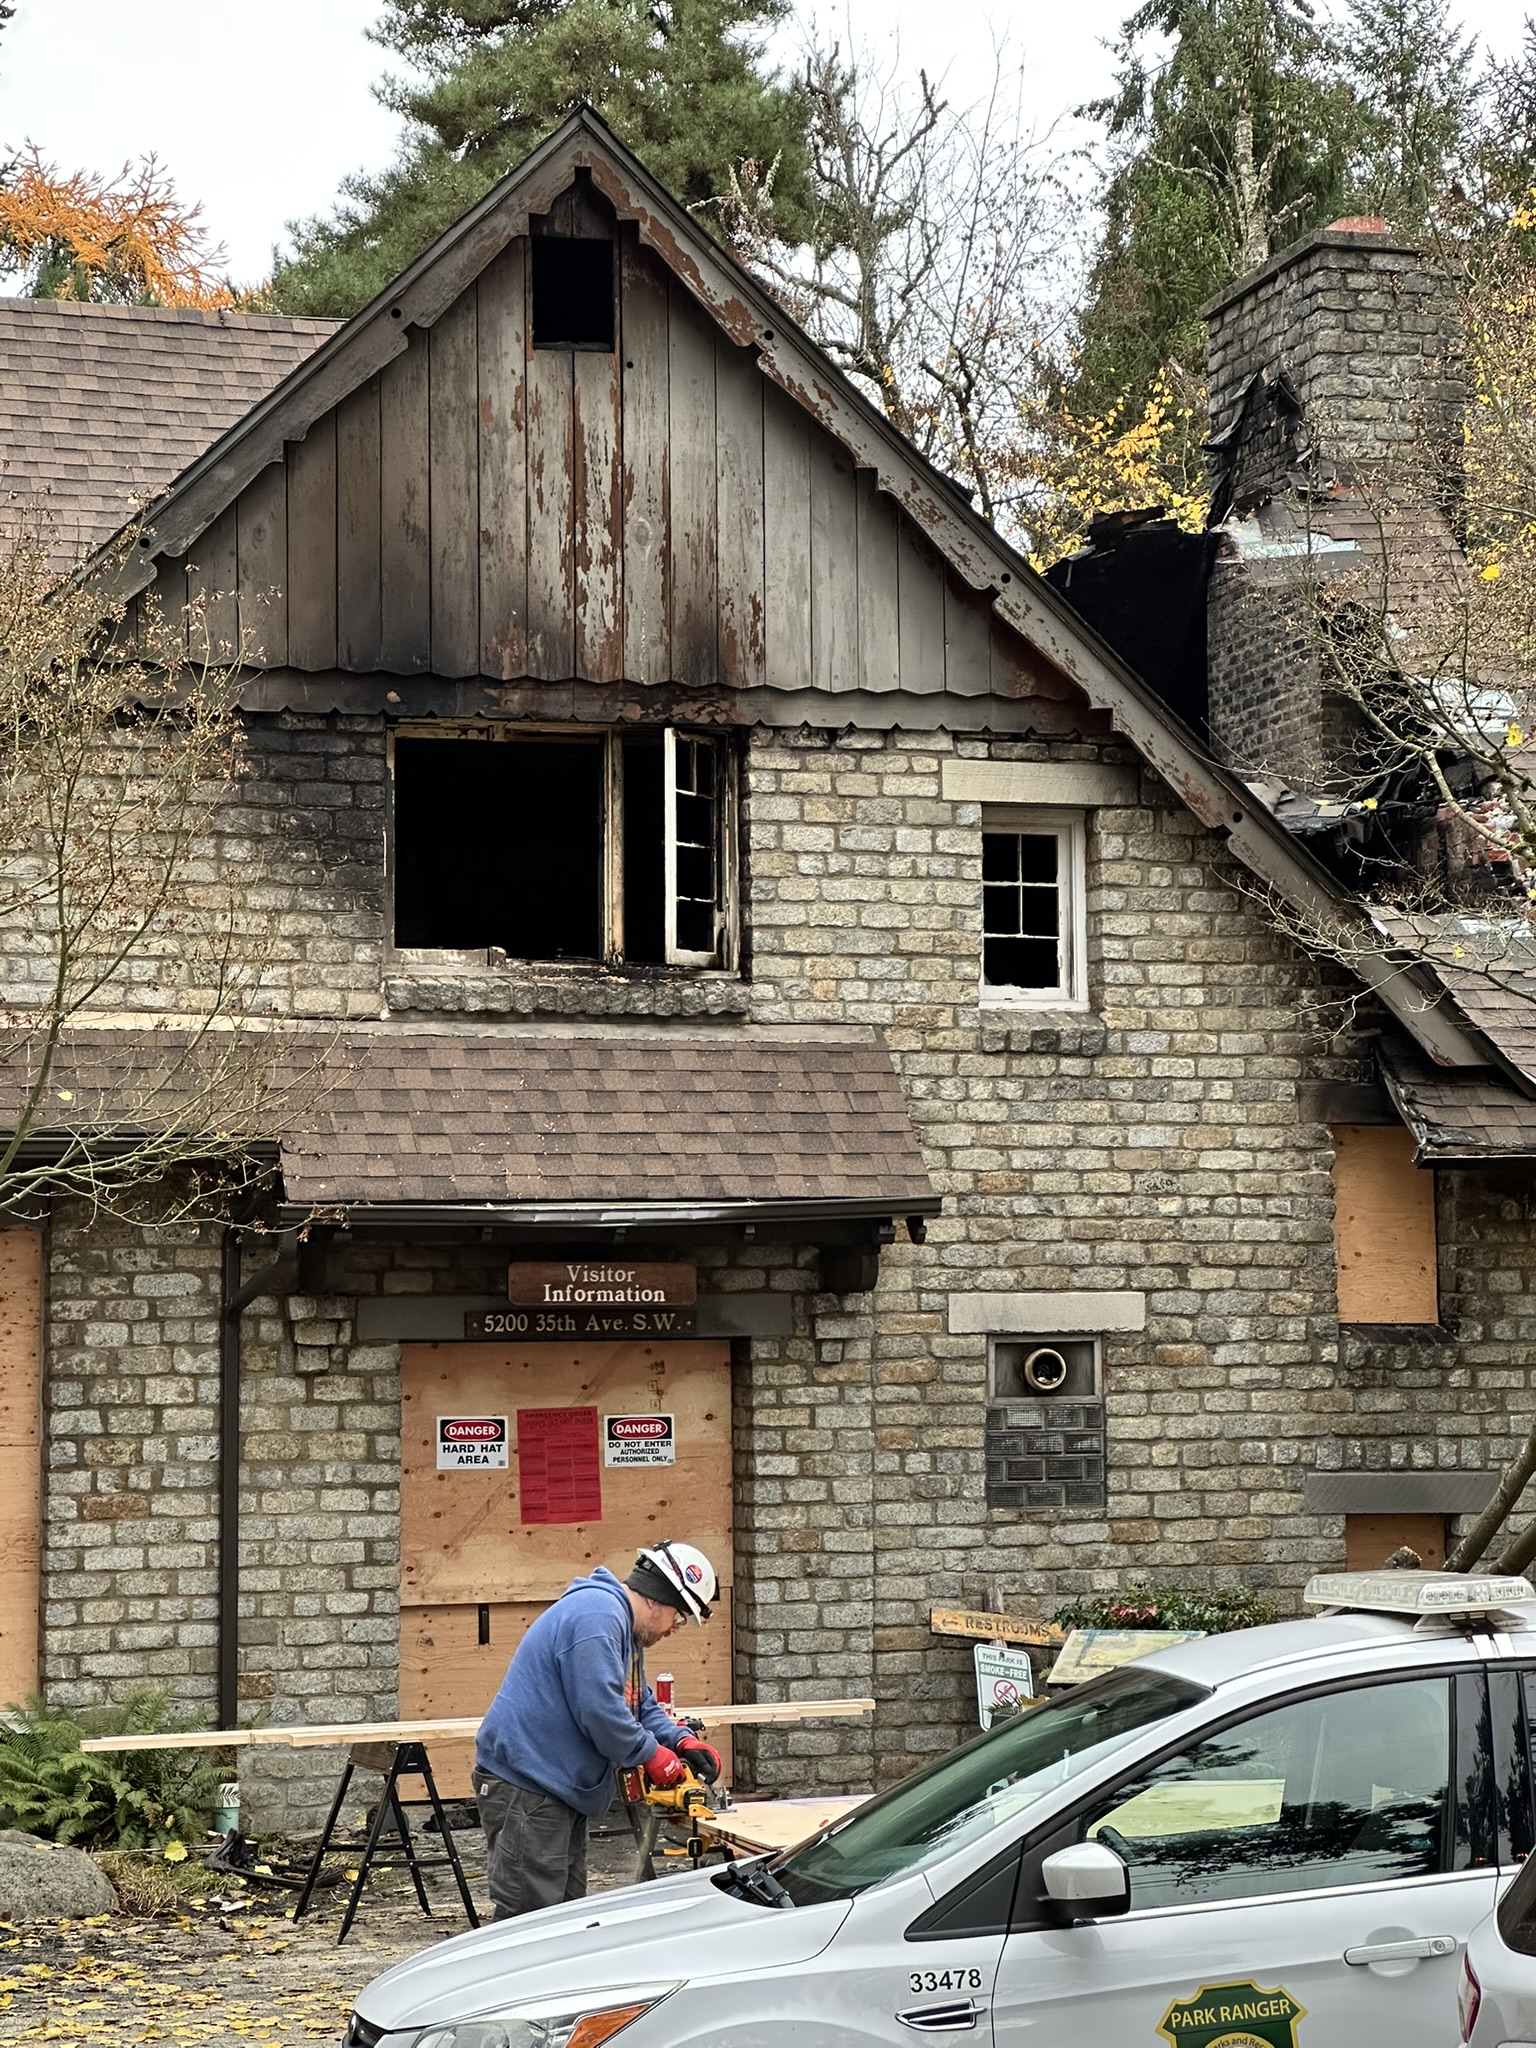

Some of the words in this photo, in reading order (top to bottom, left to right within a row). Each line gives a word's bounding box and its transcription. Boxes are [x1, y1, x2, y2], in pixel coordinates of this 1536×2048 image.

[566, 1264, 636, 1283] Visitor
[543, 1284, 667, 1302] Information
[483, 1314, 529, 1333] 5200
[535, 1314, 577, 1332] 35th
[585, 1314, 629, 1332] Ave.
[633, 1313, 682, 1331] S.W.
[449, 1426, 496, 1436] DANGER
[616, 1423, 663, 1434] DANGER
[442, 1444, 476, 1453] HARD
[480, 1444, 503, 1453] HAT
[457, 1455, 490, 1464] AREA
[965, 1615, 1051, 1638] RESTROOMS
[982, 1653, 997, 1661] THIS
[1016, 1658, 1024, 1666] IS
[980, 1663, 1028, 1680] SMOKE-FREE
[910, 1968, 982, 1993] 33478
[1171, 2007, 1218, 2029] PARK
[1219, 1998, 1292, 2023] RANGER
[1231, 2036, 1249, 2046] and
[1248, 2037, 1268, 2048] Rec
